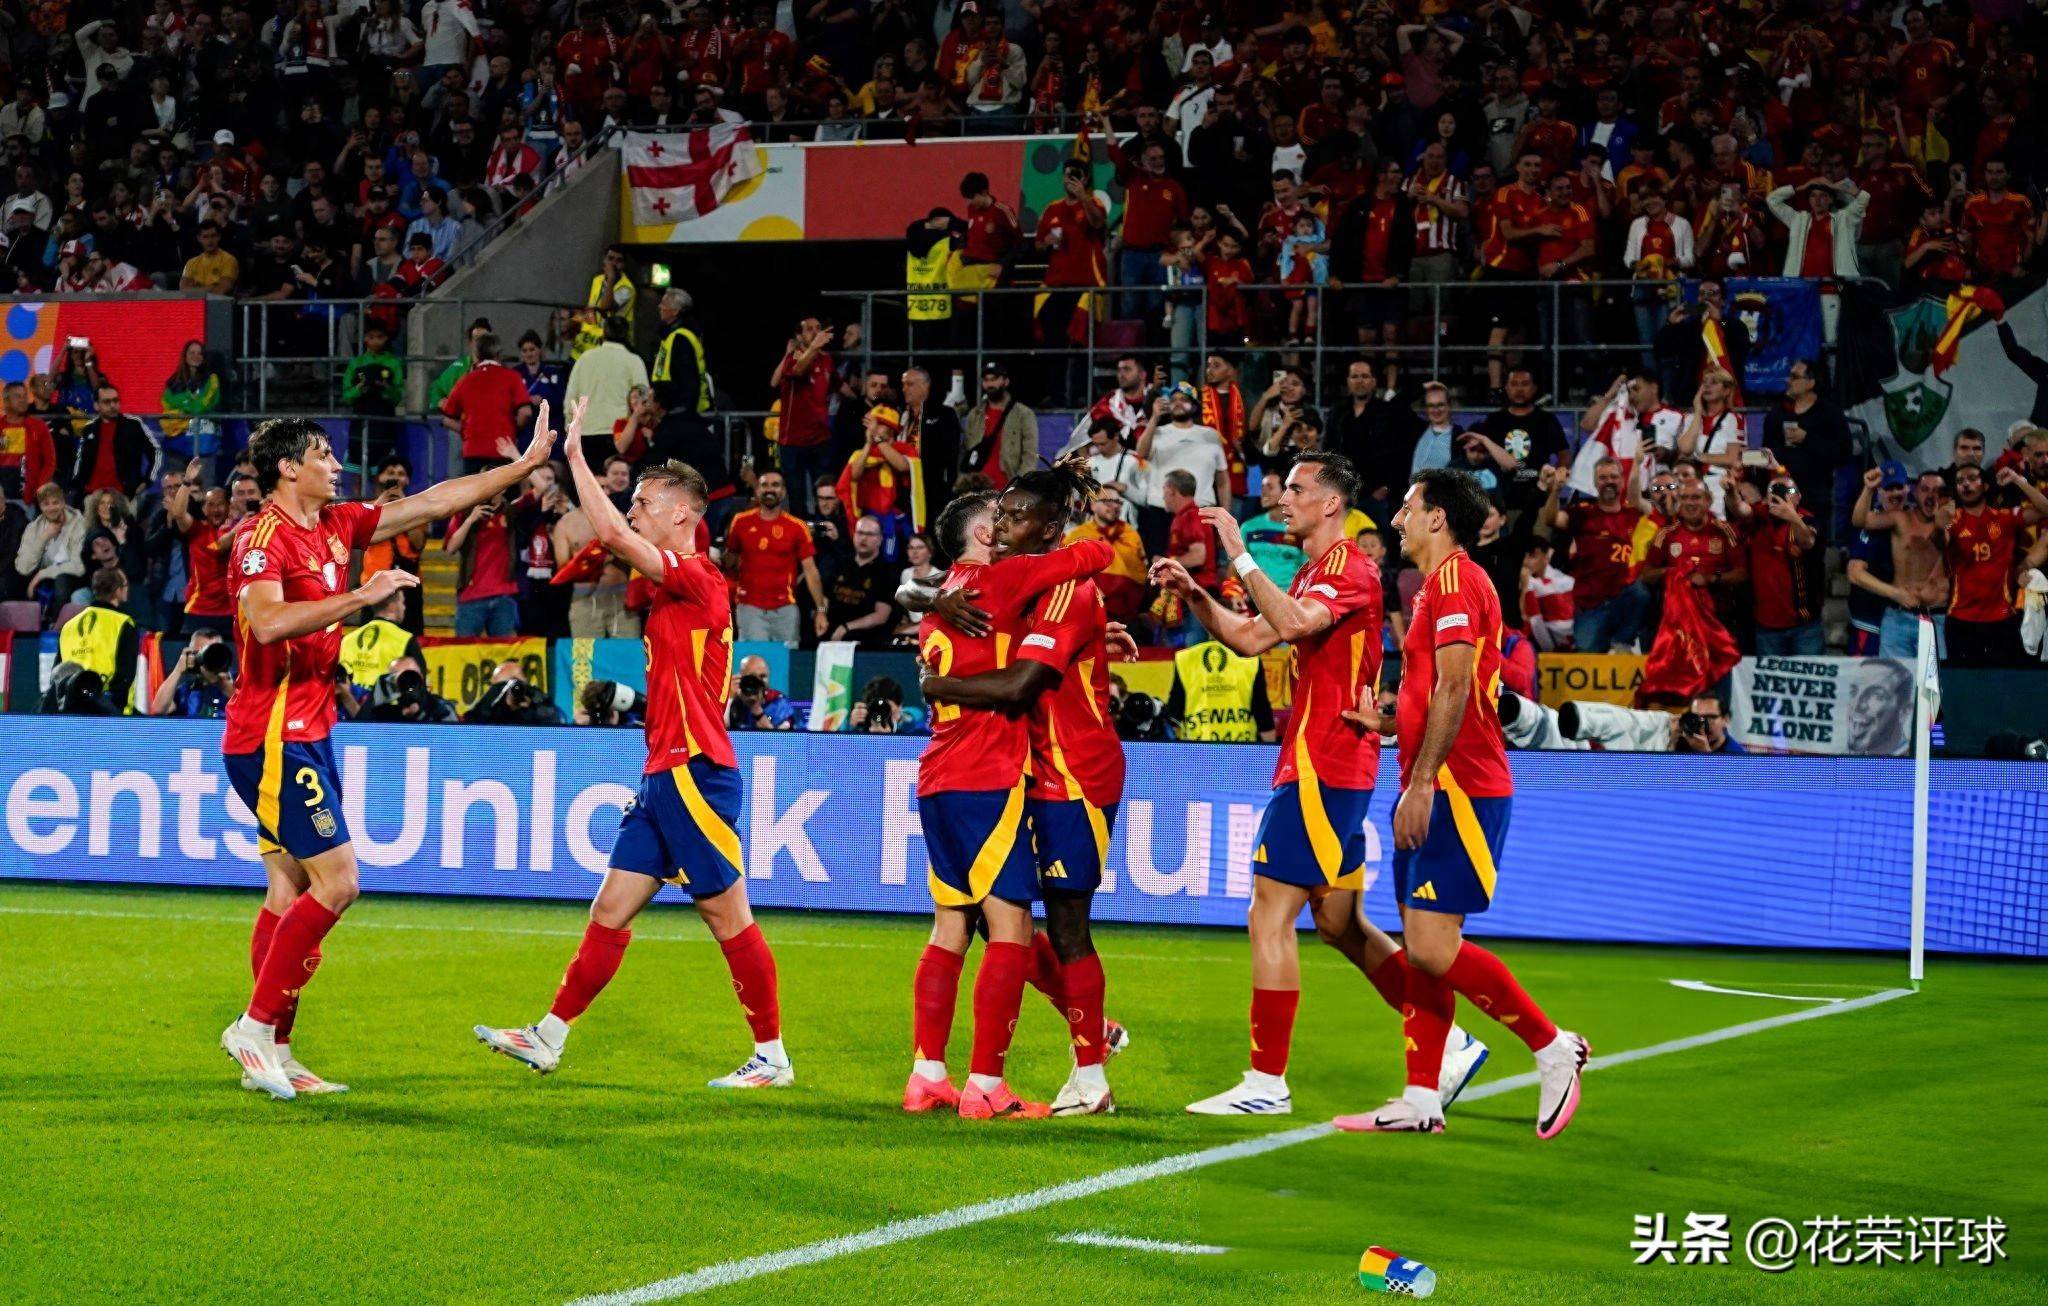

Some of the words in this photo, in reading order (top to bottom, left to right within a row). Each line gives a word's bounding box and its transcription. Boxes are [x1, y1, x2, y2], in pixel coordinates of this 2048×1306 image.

[1972, 542, 1991, 562] 19
[1755, 655, 1838, 678] LEGENDS
[1752, 673, 1836, 699] NEVER
[1751, 694, 1834, 720] WALK
[1747, 717, 1834, 743] ALONE
[295, 767, 324, 807] 3
